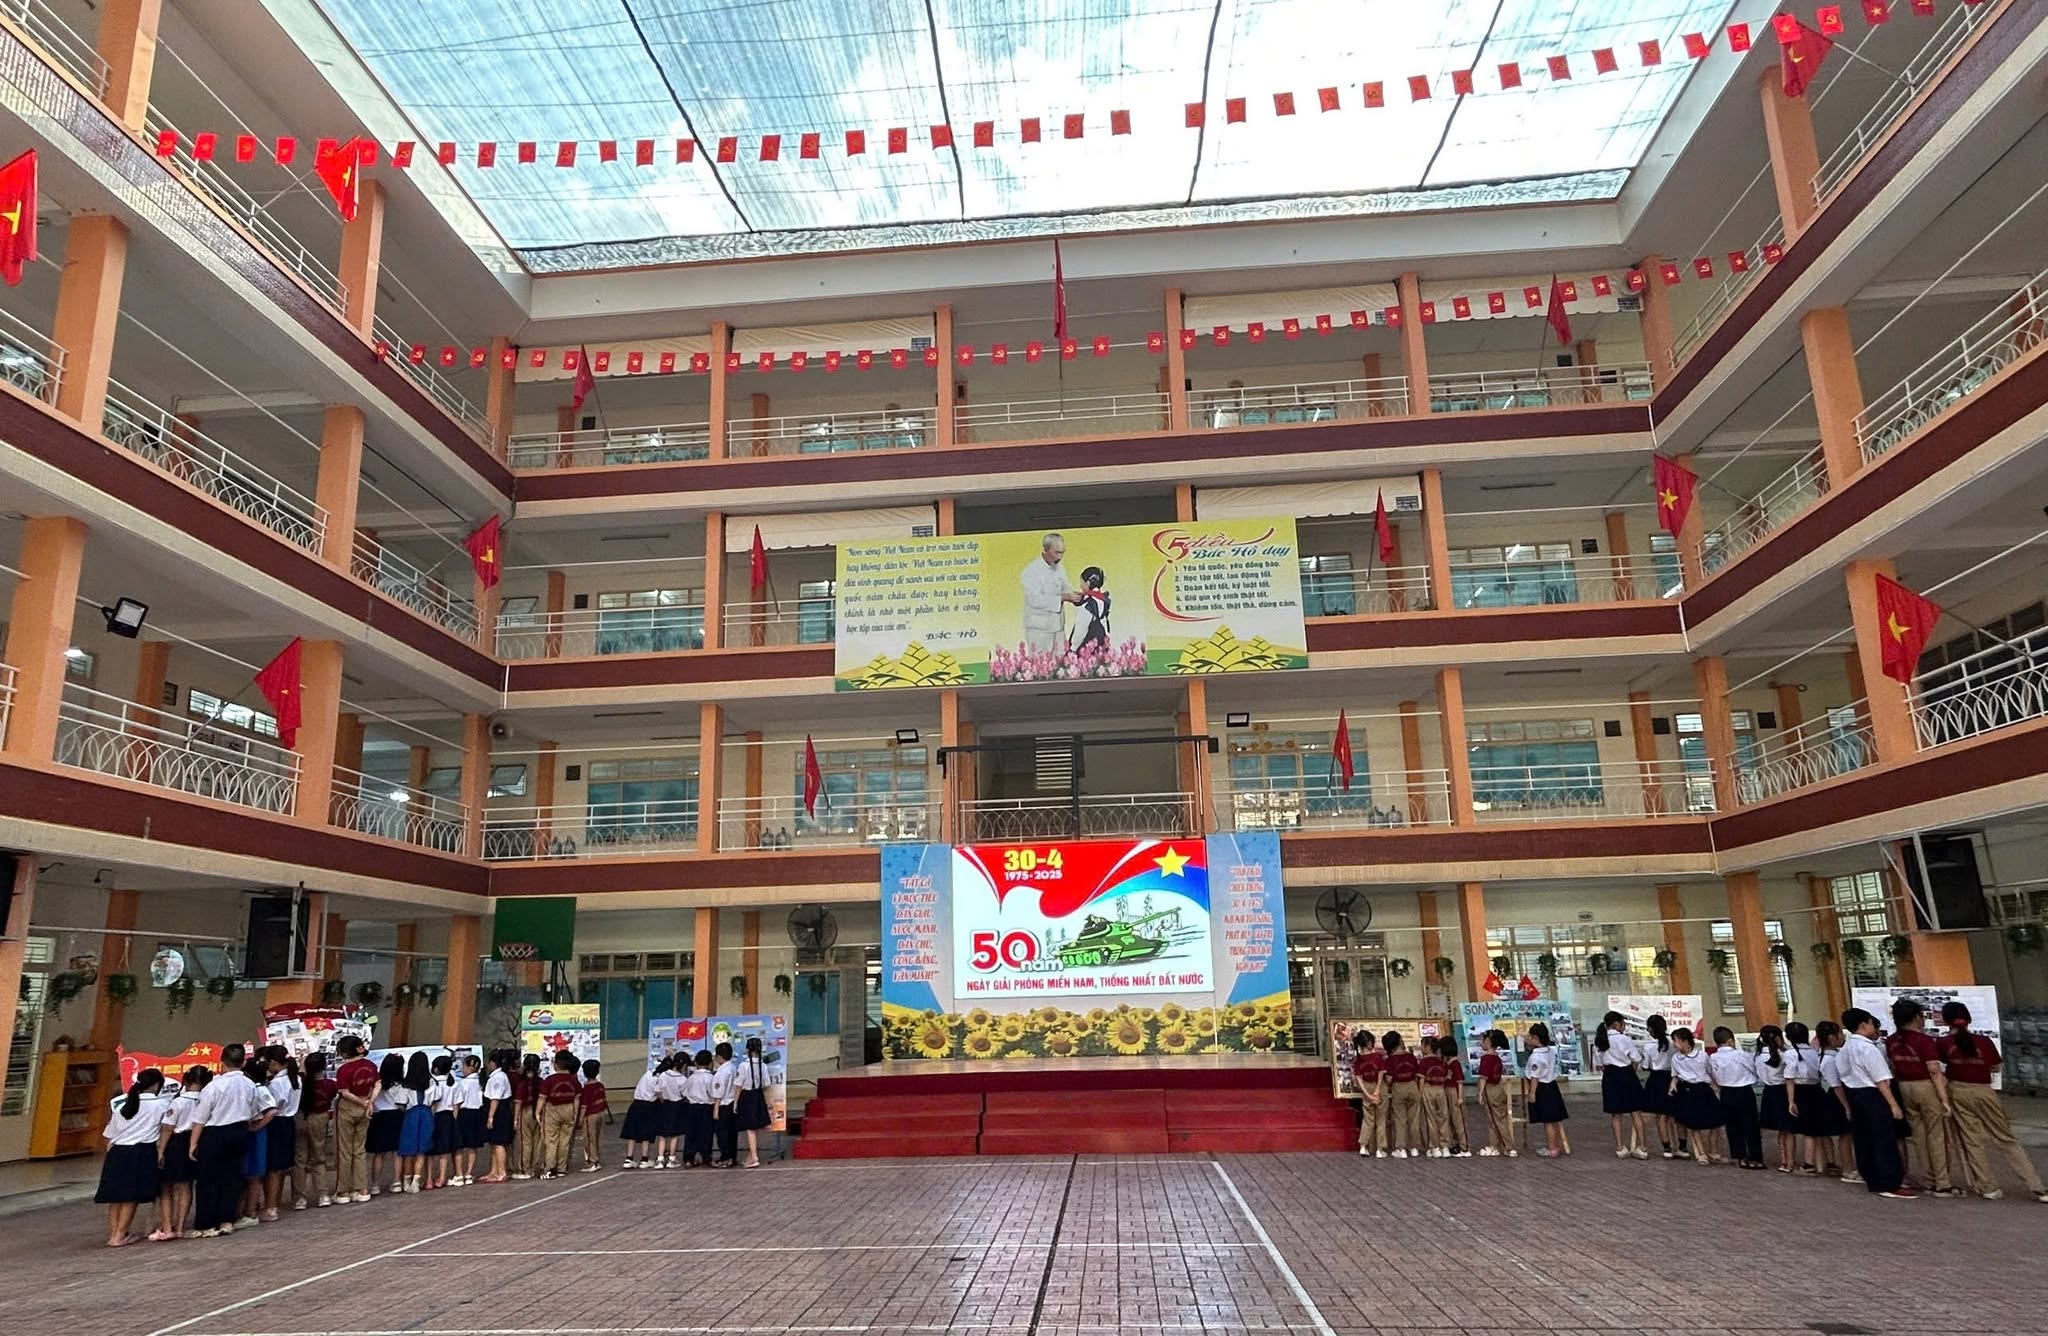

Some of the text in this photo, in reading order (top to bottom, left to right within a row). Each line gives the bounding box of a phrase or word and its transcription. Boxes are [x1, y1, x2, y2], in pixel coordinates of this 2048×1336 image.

[1168, 537, 1190, 560] 5
[1192, 545, 1291, 559] Bác Hồ dạy
[933, 588, 949, 600] hay
[1004, 848, 1064, 871] 30-4
[970, 928, 1038, 972] 50
[1020, 958, 1064, 973] năm
[967, 971, 1204, 992] NGÀY GIẢI PHÓNG MIỀN NAM, THỐNG NHẤT ĐẤT NƯỚC
